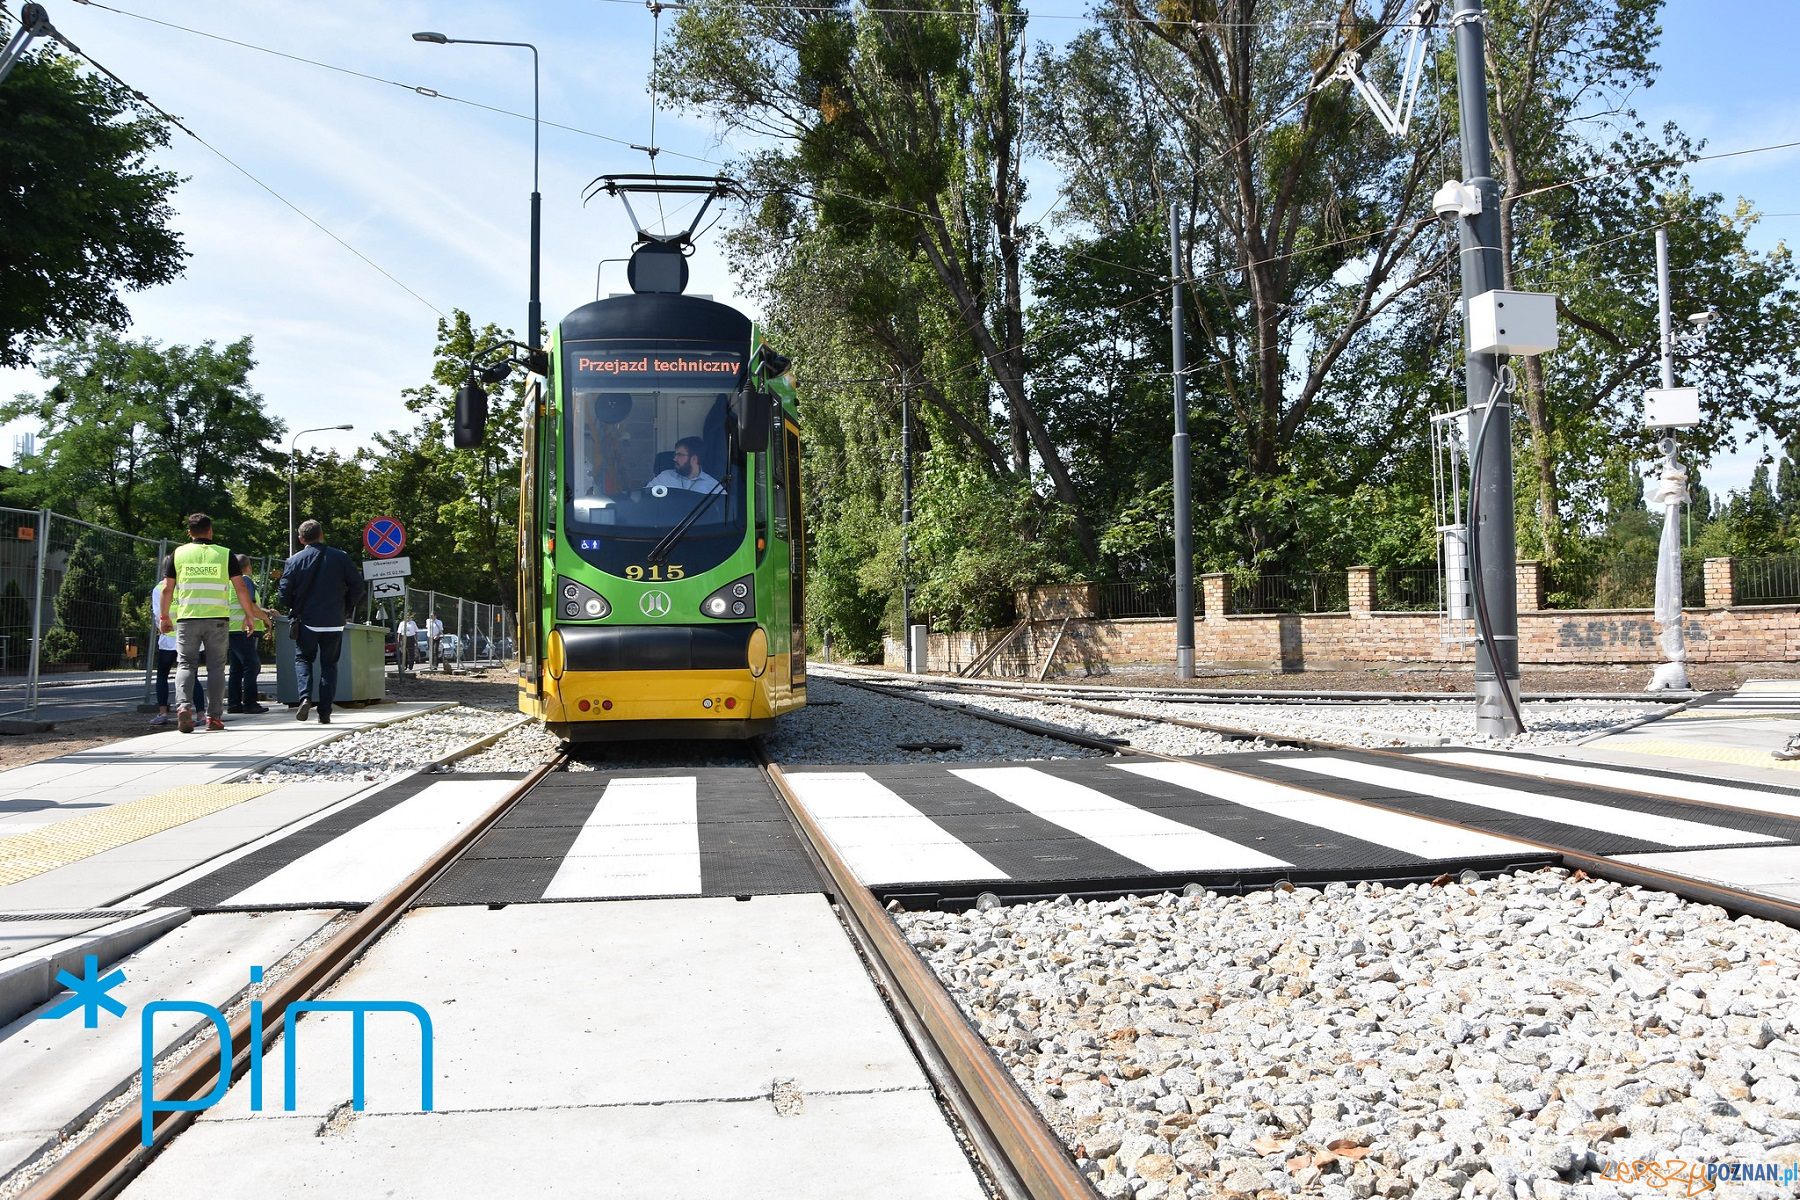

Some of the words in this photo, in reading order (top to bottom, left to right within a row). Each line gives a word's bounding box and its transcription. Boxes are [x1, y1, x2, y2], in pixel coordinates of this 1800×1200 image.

[579, 357, 648, 375] Przejazd
[654, 357, 741, 375] techniczny
[625, 564, 685, 581] 915
